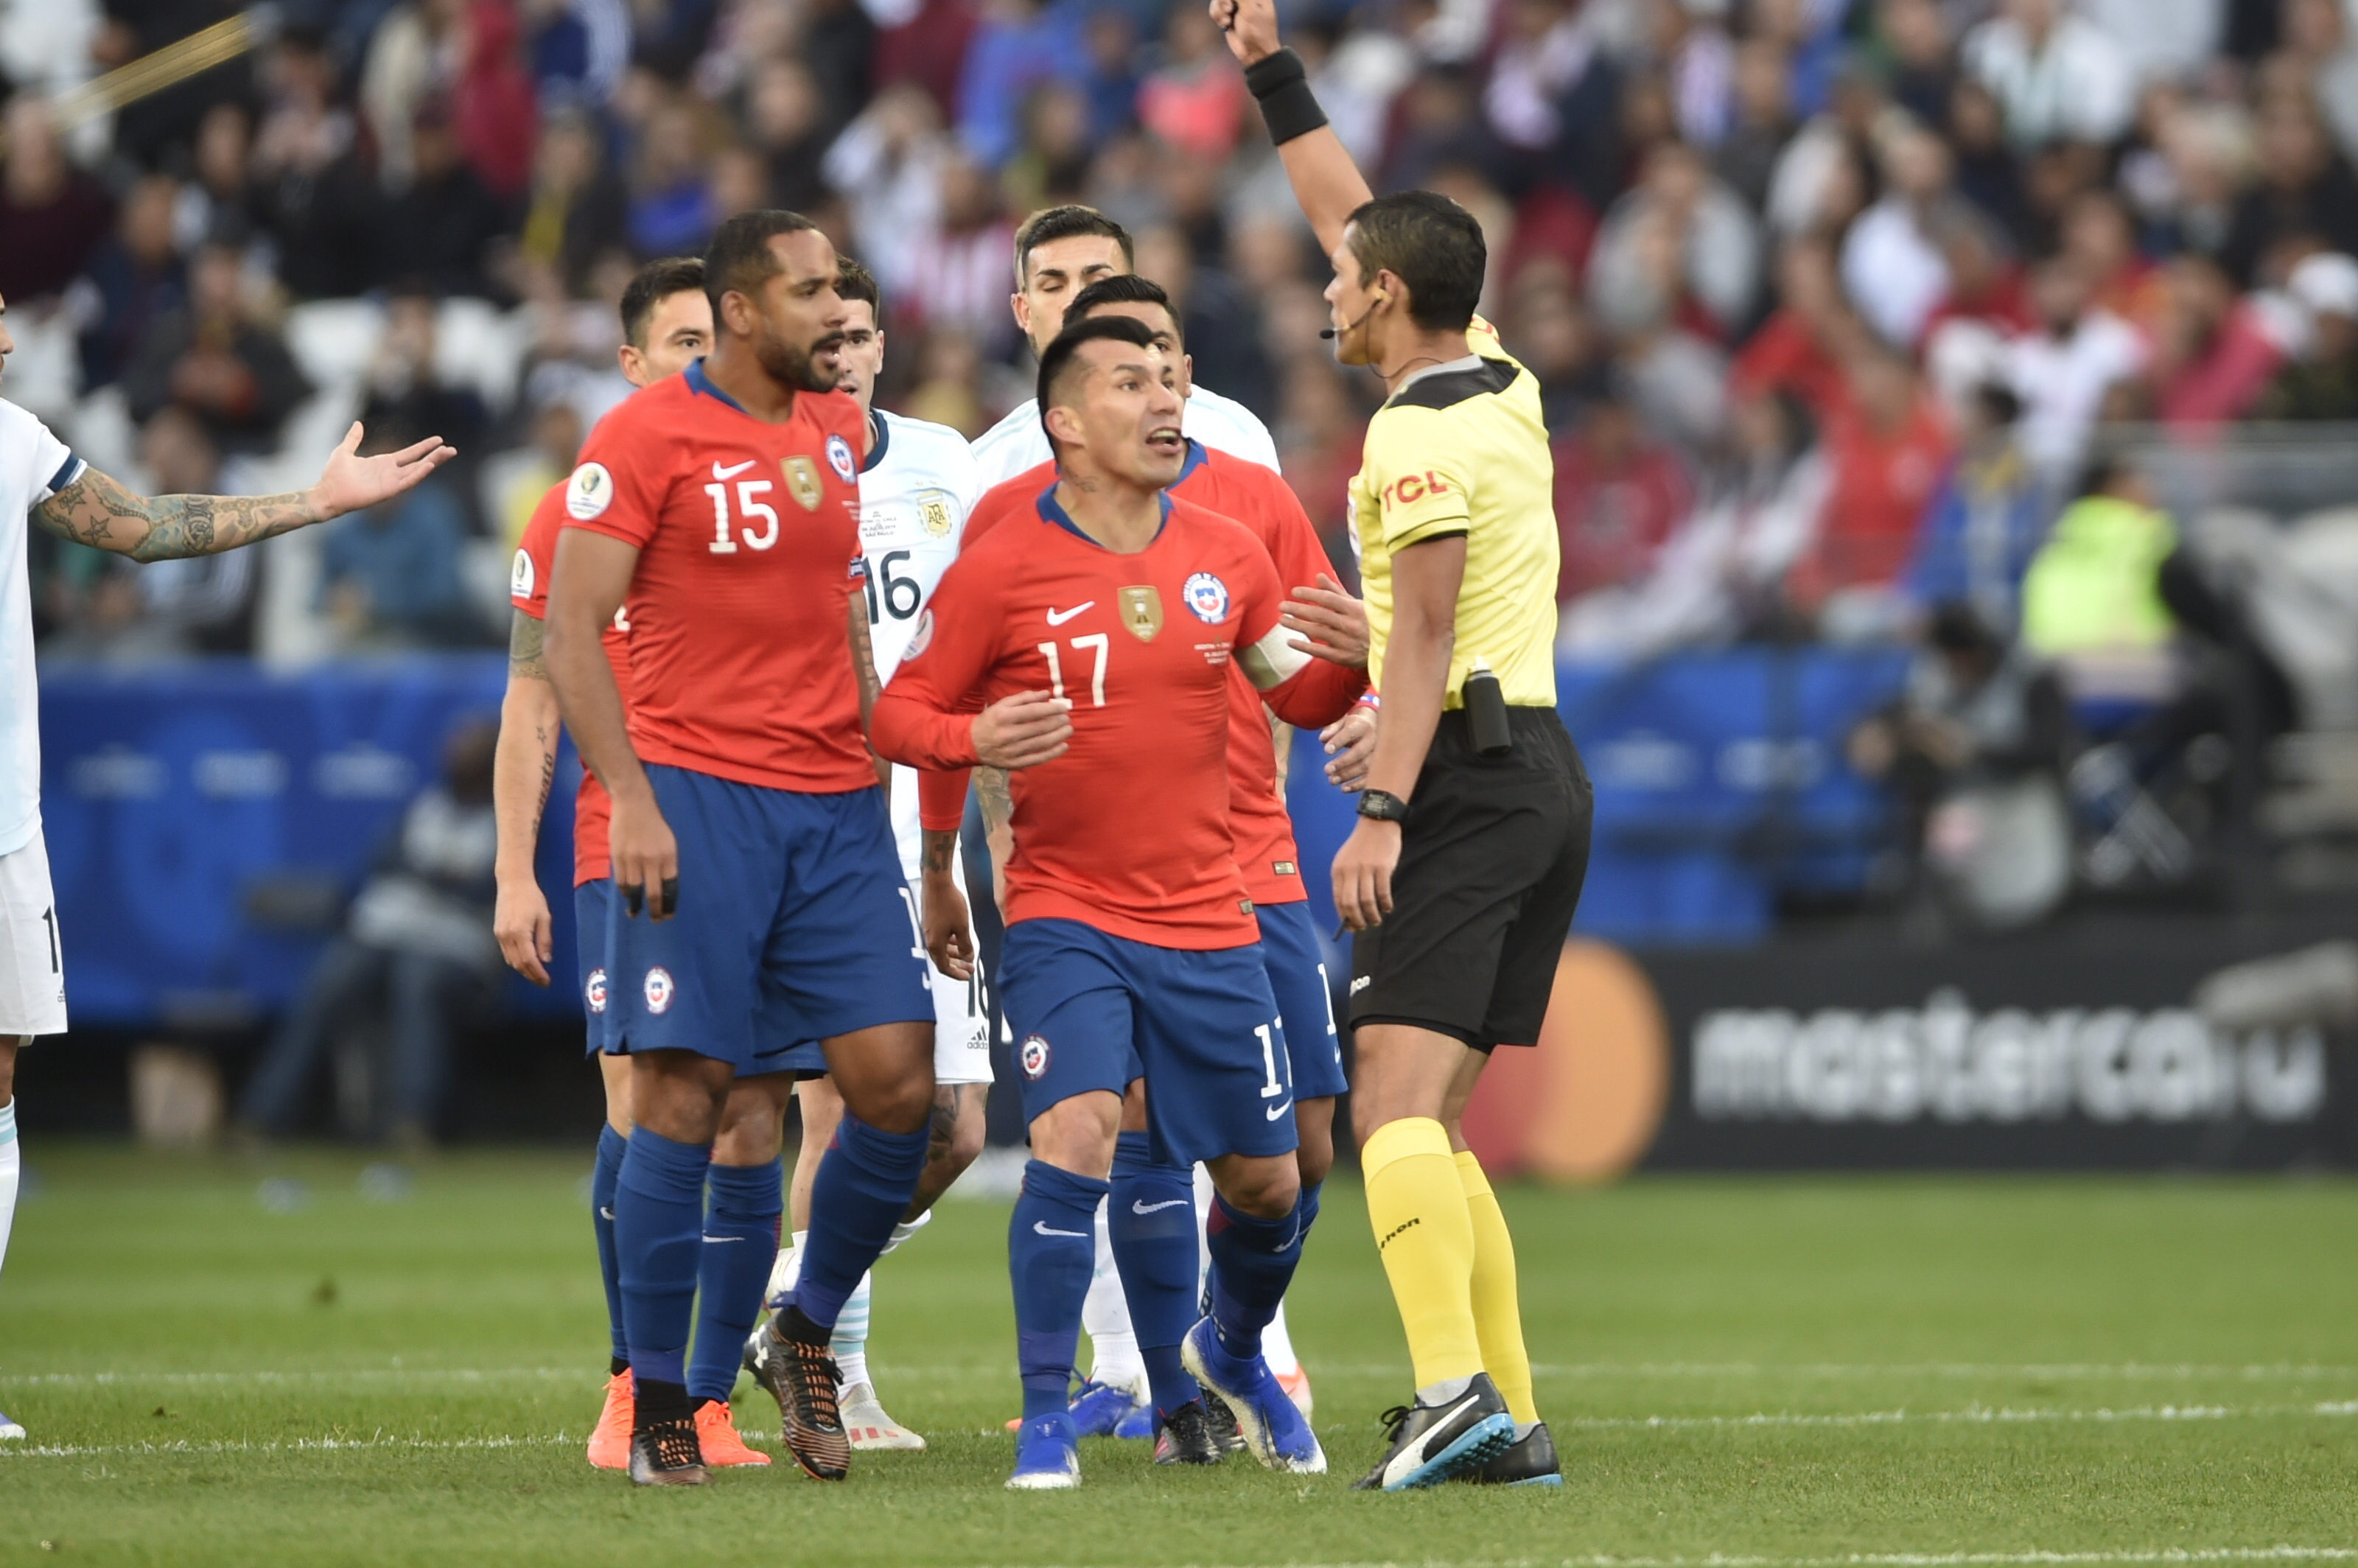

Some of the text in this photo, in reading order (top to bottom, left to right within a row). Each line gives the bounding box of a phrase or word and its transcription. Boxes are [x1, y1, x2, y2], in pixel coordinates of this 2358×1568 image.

[704, 480, 780, 553] 15
[861, 550, 921, 626] 16
[1037, 632, 1109, 710] 17
